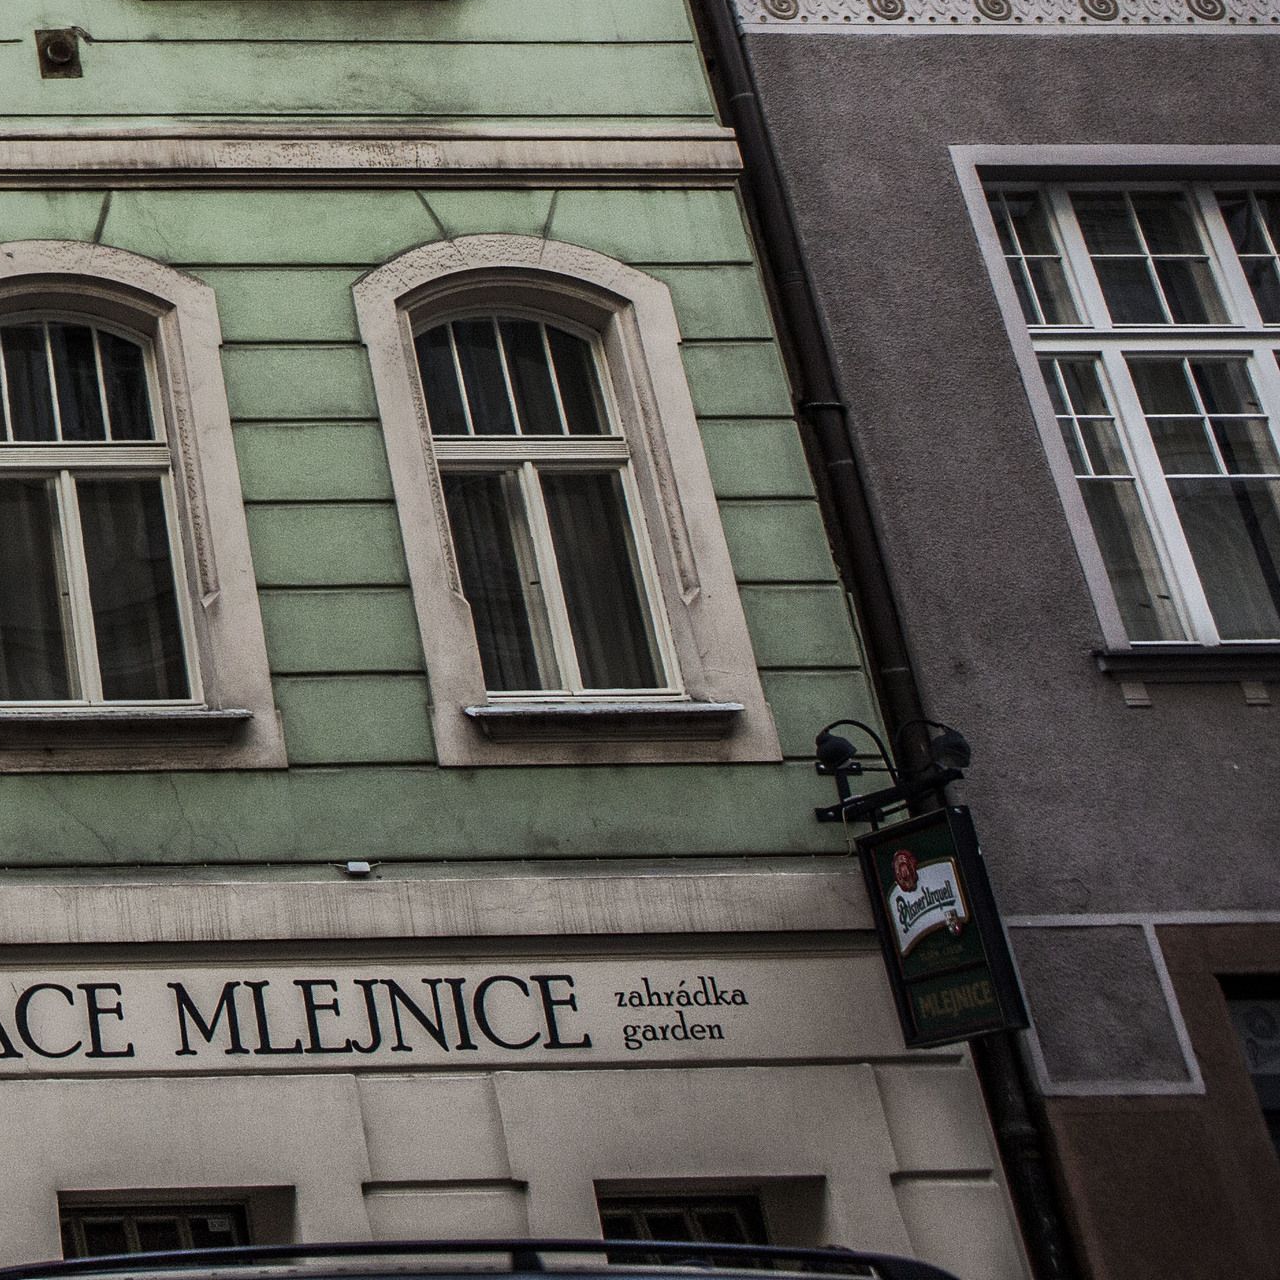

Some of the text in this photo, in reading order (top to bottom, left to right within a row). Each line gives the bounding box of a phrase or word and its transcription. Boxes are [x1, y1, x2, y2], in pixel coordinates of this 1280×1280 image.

[614, 976, 749, 1008] zahrádka
[167, 974, 592, 1055] MLEJNICE
[623, 1011, 725, 1049] garden
